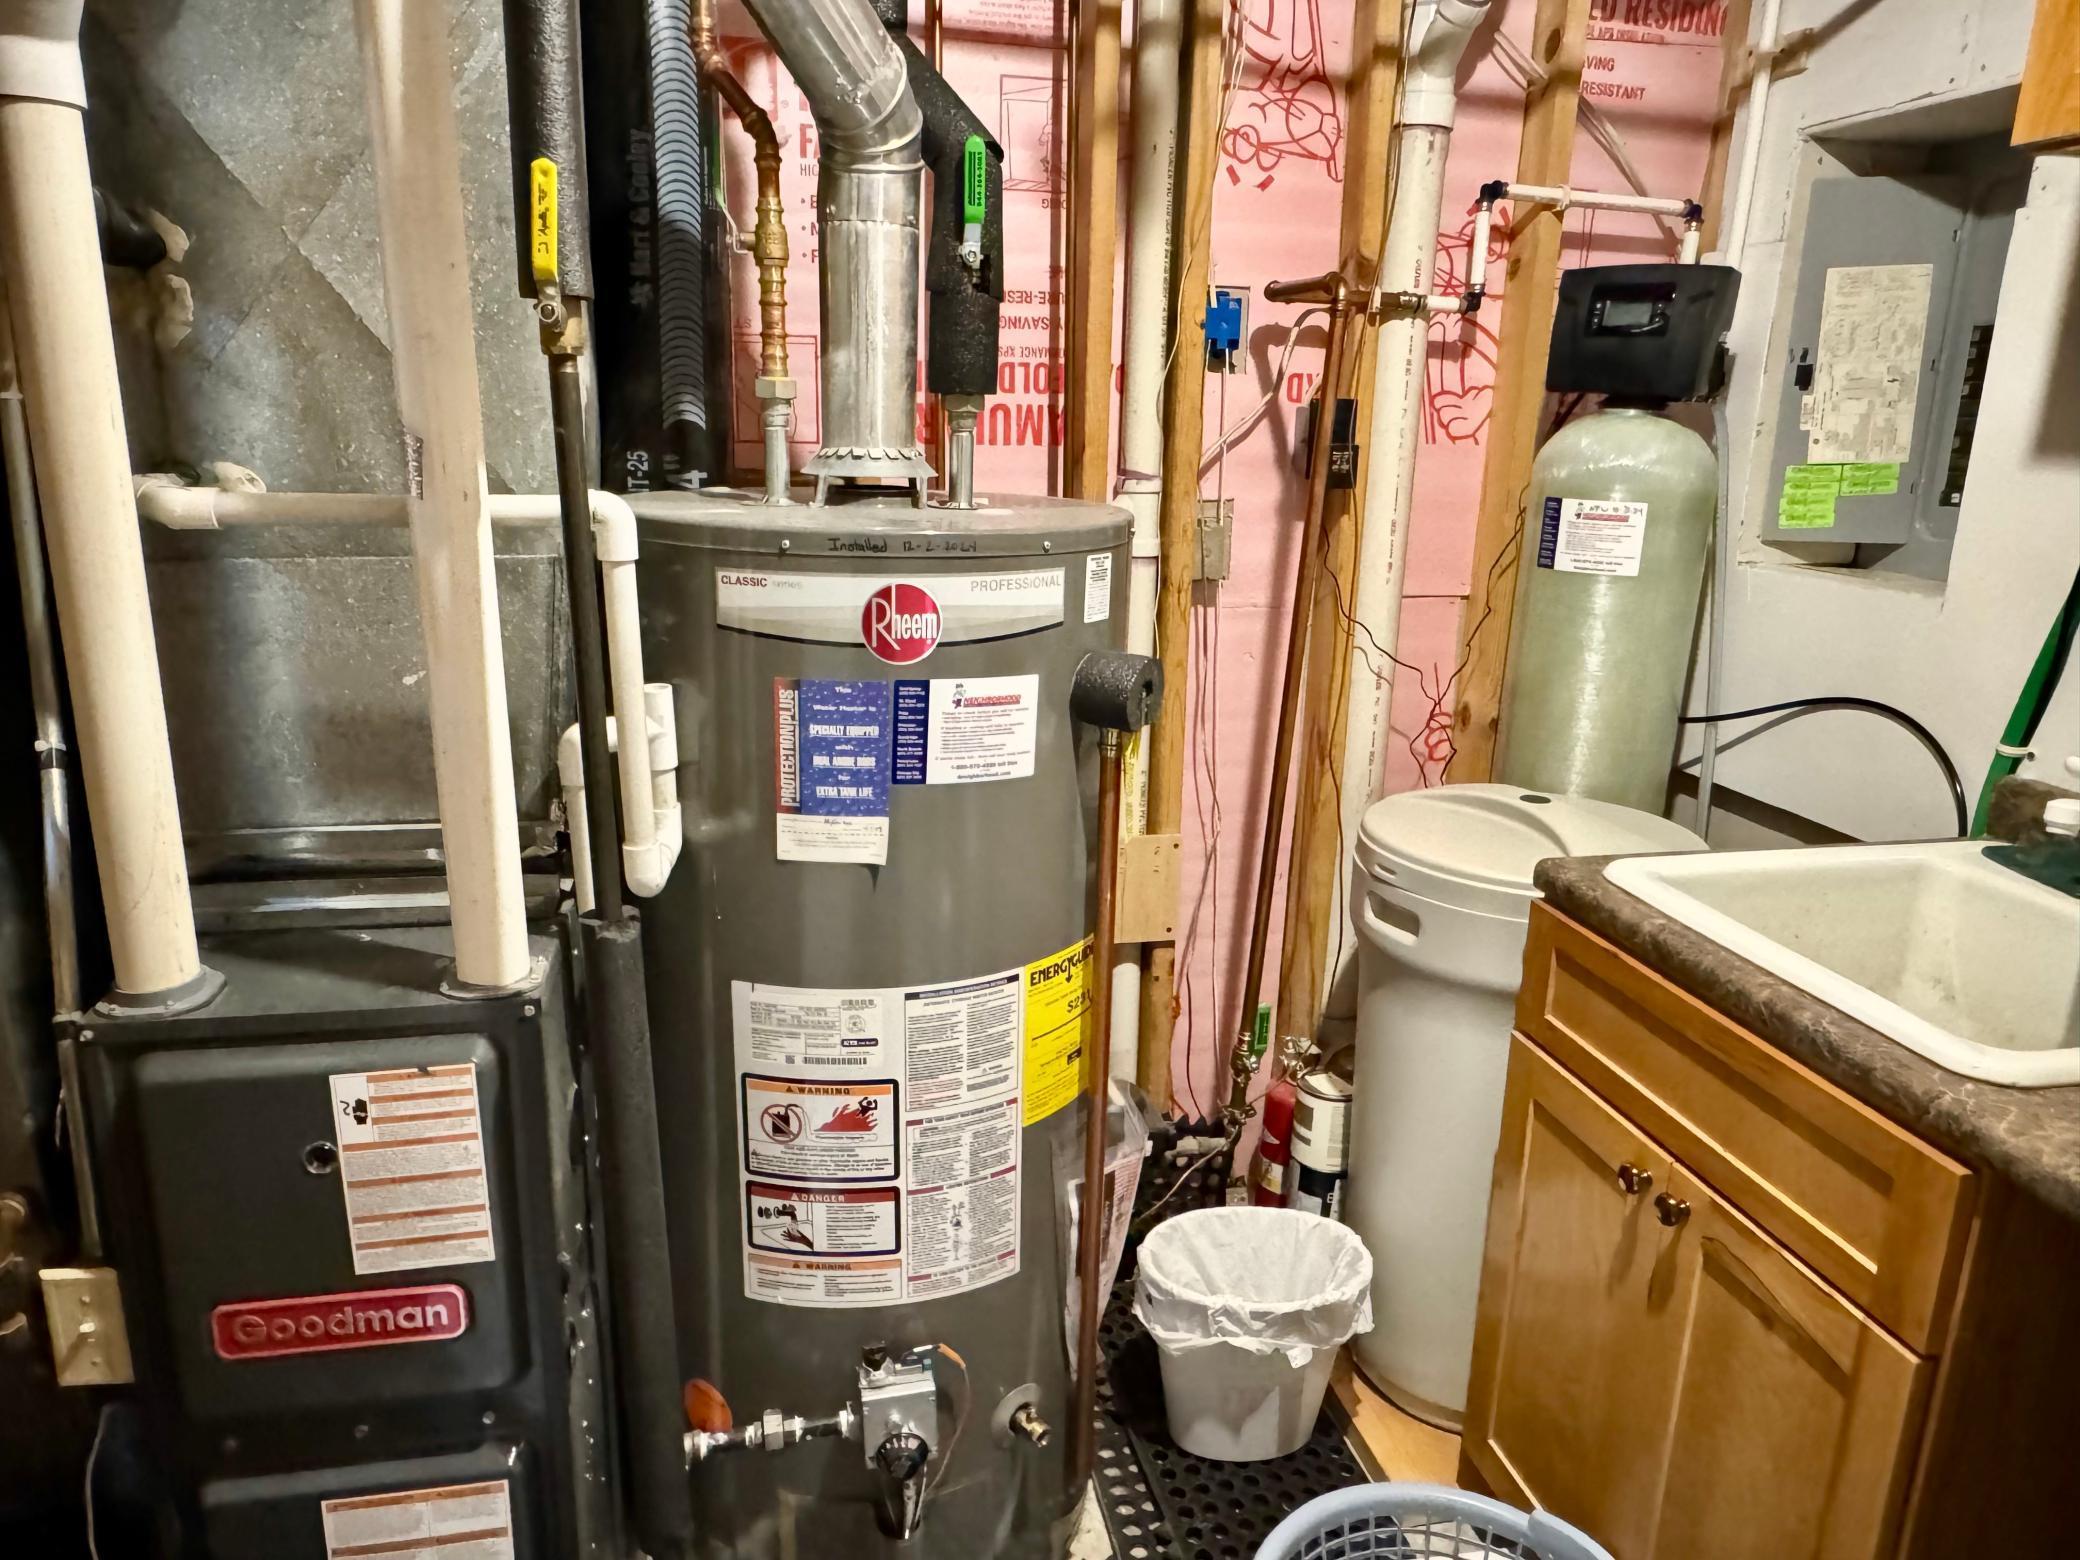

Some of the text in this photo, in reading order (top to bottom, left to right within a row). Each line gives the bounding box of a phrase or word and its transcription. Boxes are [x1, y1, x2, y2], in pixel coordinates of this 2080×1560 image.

[828, 538, 888, 553] Installed
[721, 575, 768, 587] CLASSIC
[970, 575, 1061, 592] PROFESSIONAL
[871, 584, 938, 650] Rheem
[797, 1086, 850, 1096] WARNING
[801, 1194, 845, 1203] DANGER
[806, 1263, 852, 1271] WARNING
[233, 1304, 449, 1344] Goodman
